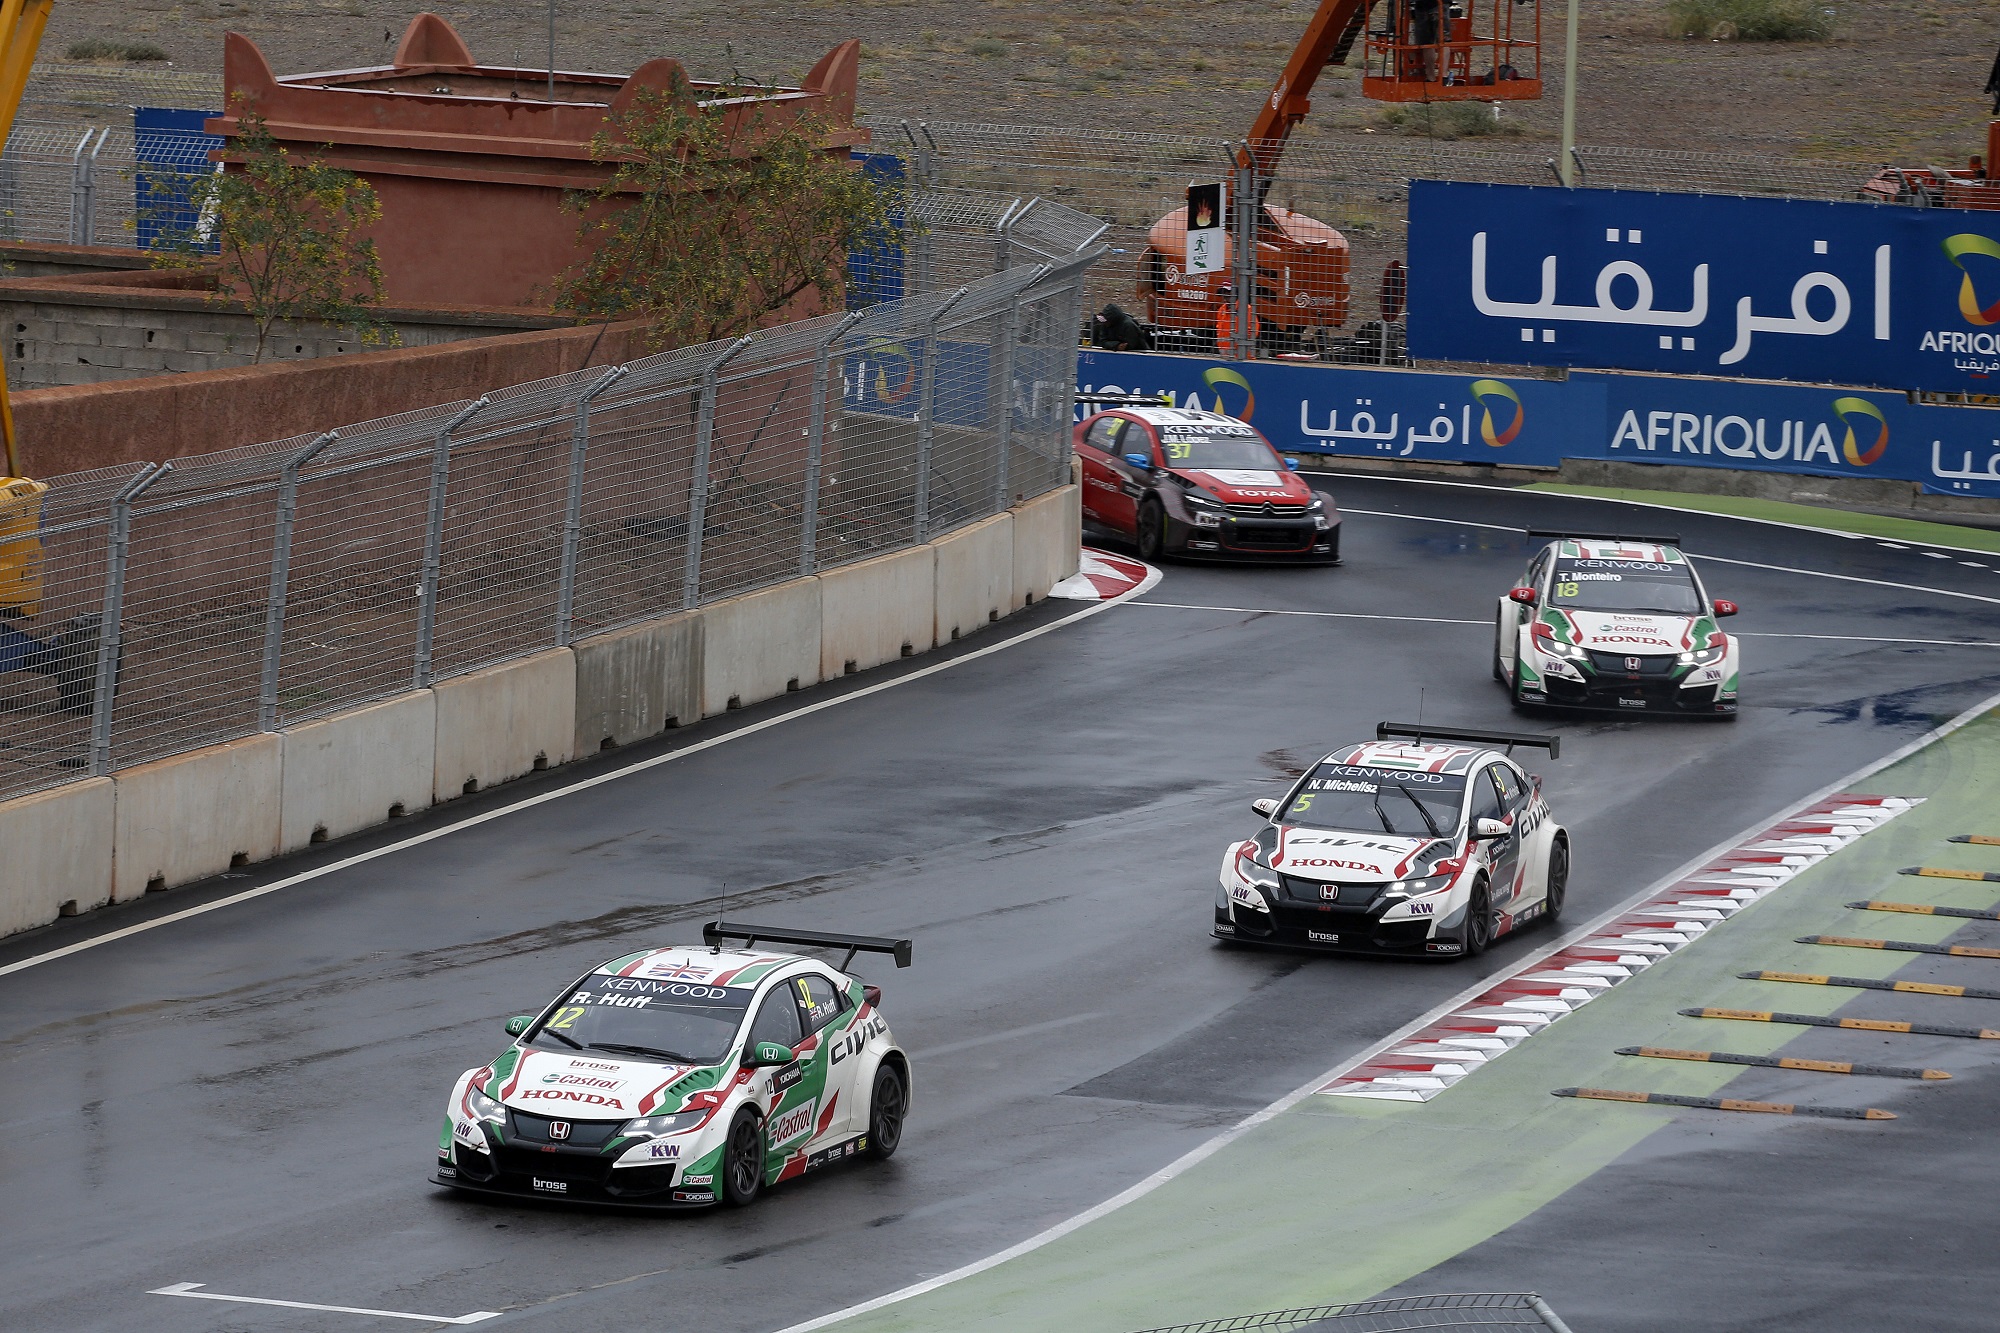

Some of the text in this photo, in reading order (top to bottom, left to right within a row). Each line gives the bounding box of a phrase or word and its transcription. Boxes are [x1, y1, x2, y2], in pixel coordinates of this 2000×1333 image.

[1472, 228, 1891, 365] افريقيا
[1919, 331, 2000, 355] AFRIQ
[1163, 425, 1253, 436] KENWOOD
[1301, 398, 1471, 456] افريقيا
[1611, 409, 1840, 464] AFRIQUIA
[1167, 444, 1192, 459] 37
[1231, 489, 1295, 498] TOTAL
[1574, 560, 1673, 571] KENWOOD
[1559, 573, 1622, 582] T. Monteiro
[1556, 582, 1579, 597] 18
[1613, 615, 1652, 623] brose
[1614, 625, 1658, 634] Castrol
[1591, 636, 1674, 648] HONDA
[1545, 661, 1566, 671] KW
[1705, 670, 1722, 679] KW
[1619, 697, 1646, 707] brose
[1330, 766, 1444, 784] KENWOOD
[1308, 779, 1378, 794] N. Michelisz
[1292, 794, 1315, 812] 5
[1288, 837, 1408, 855] CIVIC
[1289, 858, 1384, 875] HONDA
[1233, 887, 1251, 900] KW
[1411, 903, 1434, 915] KW
[1309, 930, 1339, 941] brose
[600, 978, 727, 1000] KENWOOD
[569, 991, 653, 1008] R. Huff
[817, 998, 837, 1019] R. Huff
[546, 1007, 586, 1029] 12
[830, 1016, 887, 1065] CIVIC
[569, 1060, 621, 1072] brose
[559, 1073, 620, 1090] Castrol
[779, 1067, 801, 1085] YOKOHAMA
[765, 1079, 773, 1095] 12
[520, 1090, 625, 1110] HONDA
[455, 1122, 473, 1137] KW
[777, 1103, 812, 1143] Castrol
[651, 1145, 680, 1157] KW
[828, 1147, 841, 1158] brose
[533, 1177, 567, 1190] brose
[691, 1176, 712, 1184] Castrol
